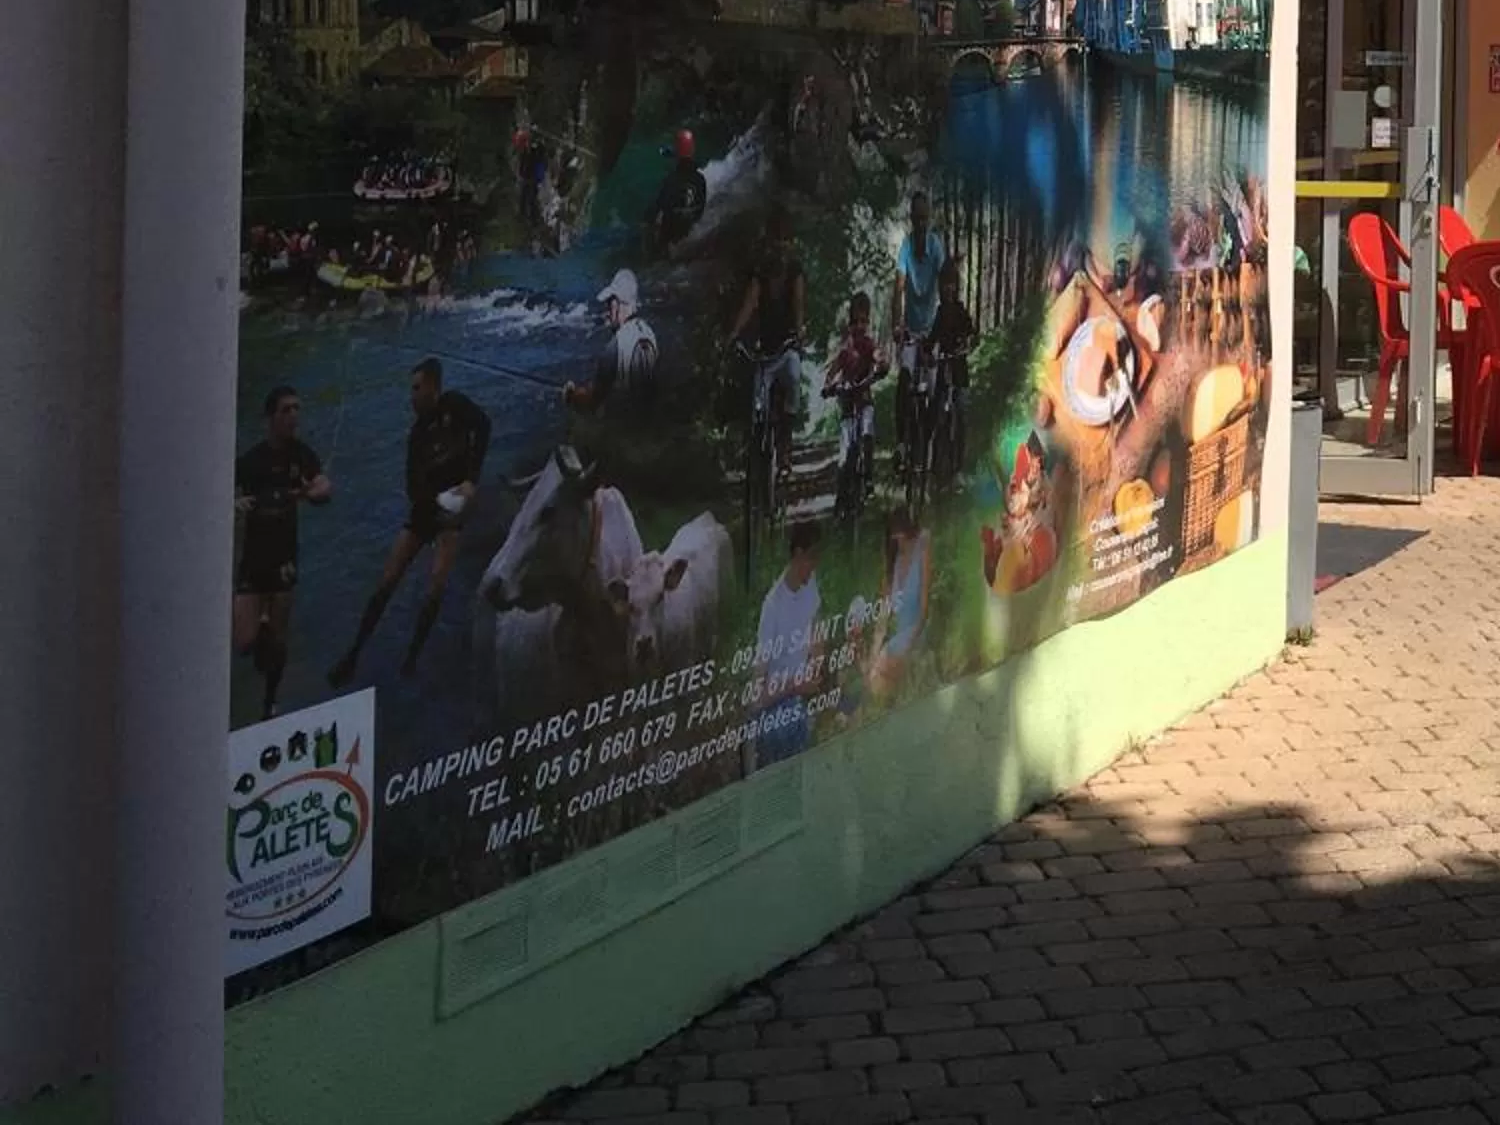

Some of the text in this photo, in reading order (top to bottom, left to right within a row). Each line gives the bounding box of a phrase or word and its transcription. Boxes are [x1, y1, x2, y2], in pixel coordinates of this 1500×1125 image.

[384, 736, 504, 806] CAMPING
[510, 708, 579, 759] PARC
[583, 694, 616, 732] DE
[618, 659, 715, 718] PALETES
[789, 614, 844, 654] SAINT
[467, 780, 511, 817] TEL
[535, 759, 562, 791] 05
[567, 743, 592, 775] 61
[600, 726, 636, 765] 660
[640, 711, 677, 746] 679
[686, 690, 729, 730] FAX
[741, 677, 765, 706] 05
[768, 668, 789, 696] 61
[301, 789, 323, 813] de
[484, 805, 545, 853] MAIL
